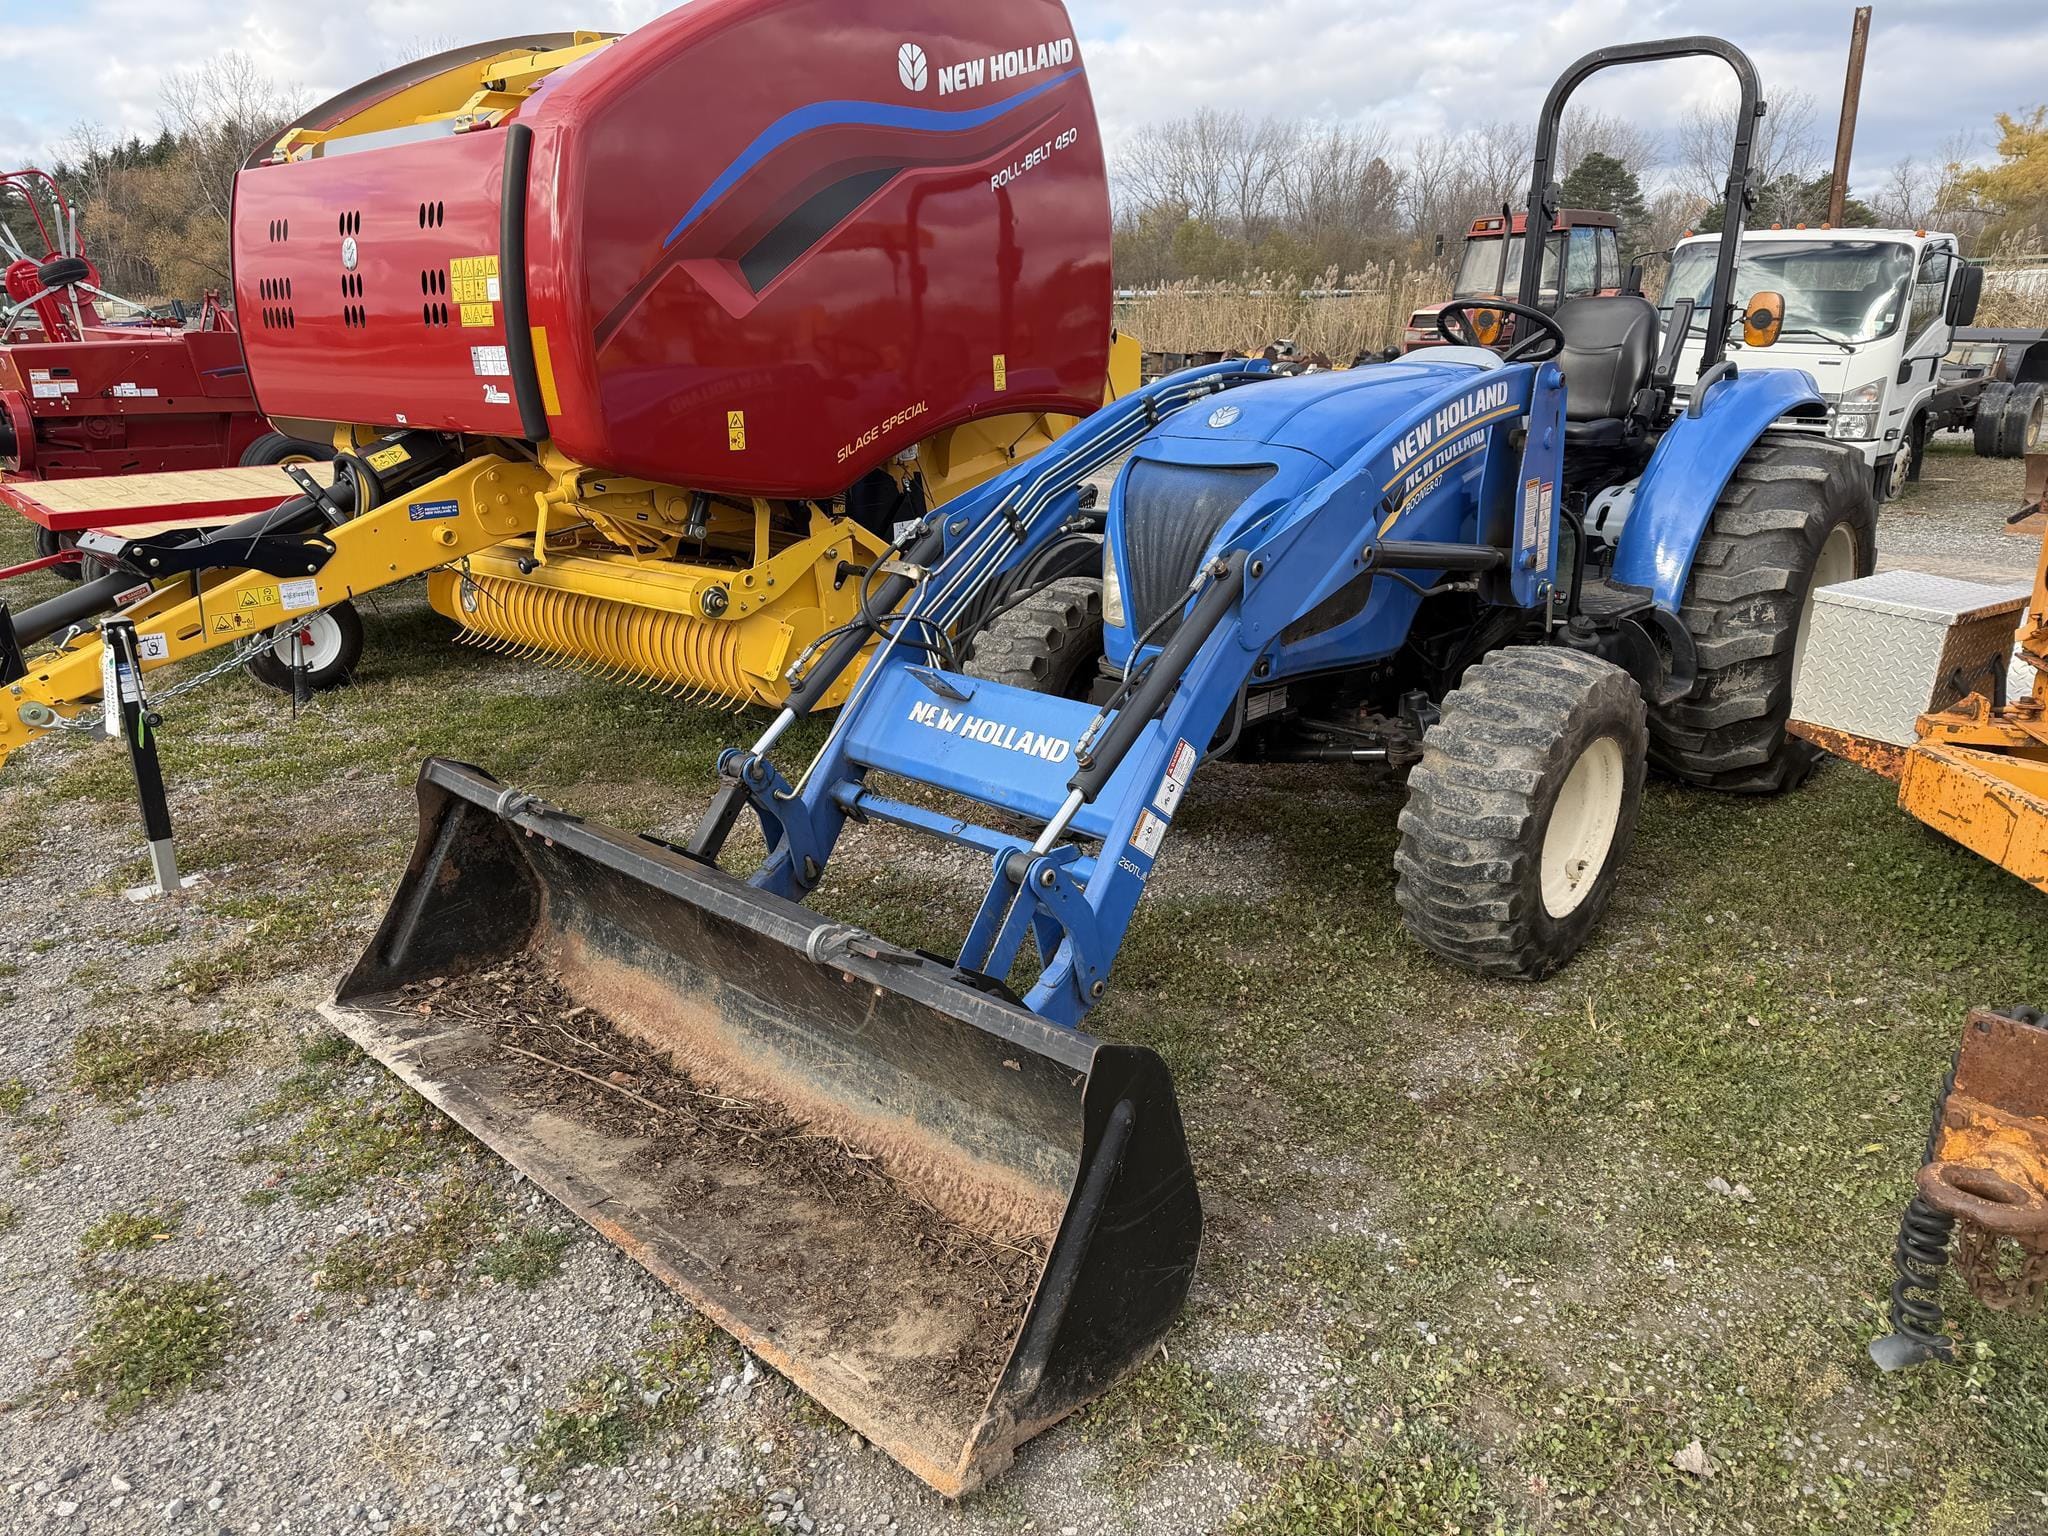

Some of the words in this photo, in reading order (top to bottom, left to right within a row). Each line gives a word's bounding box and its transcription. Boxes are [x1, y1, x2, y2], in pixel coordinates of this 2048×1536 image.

[938, 58, 985, 96] NEW
[990, 38, 1074, 82] HOLLAND
[991, 141, 1052, 192] ROLL-BELT
[1055, 127, 1077, 150] 450
[837, 425, 879, 464] SILAGE
[882, 400, 929, 434] SPECIAL
[1392, 418, 1433, 471] NEW
[1436, 381, 1508, 437] HOLLAND
[908, 701, 963, 733] NEW
[959, 715, 1071, 763] HOLLAND
